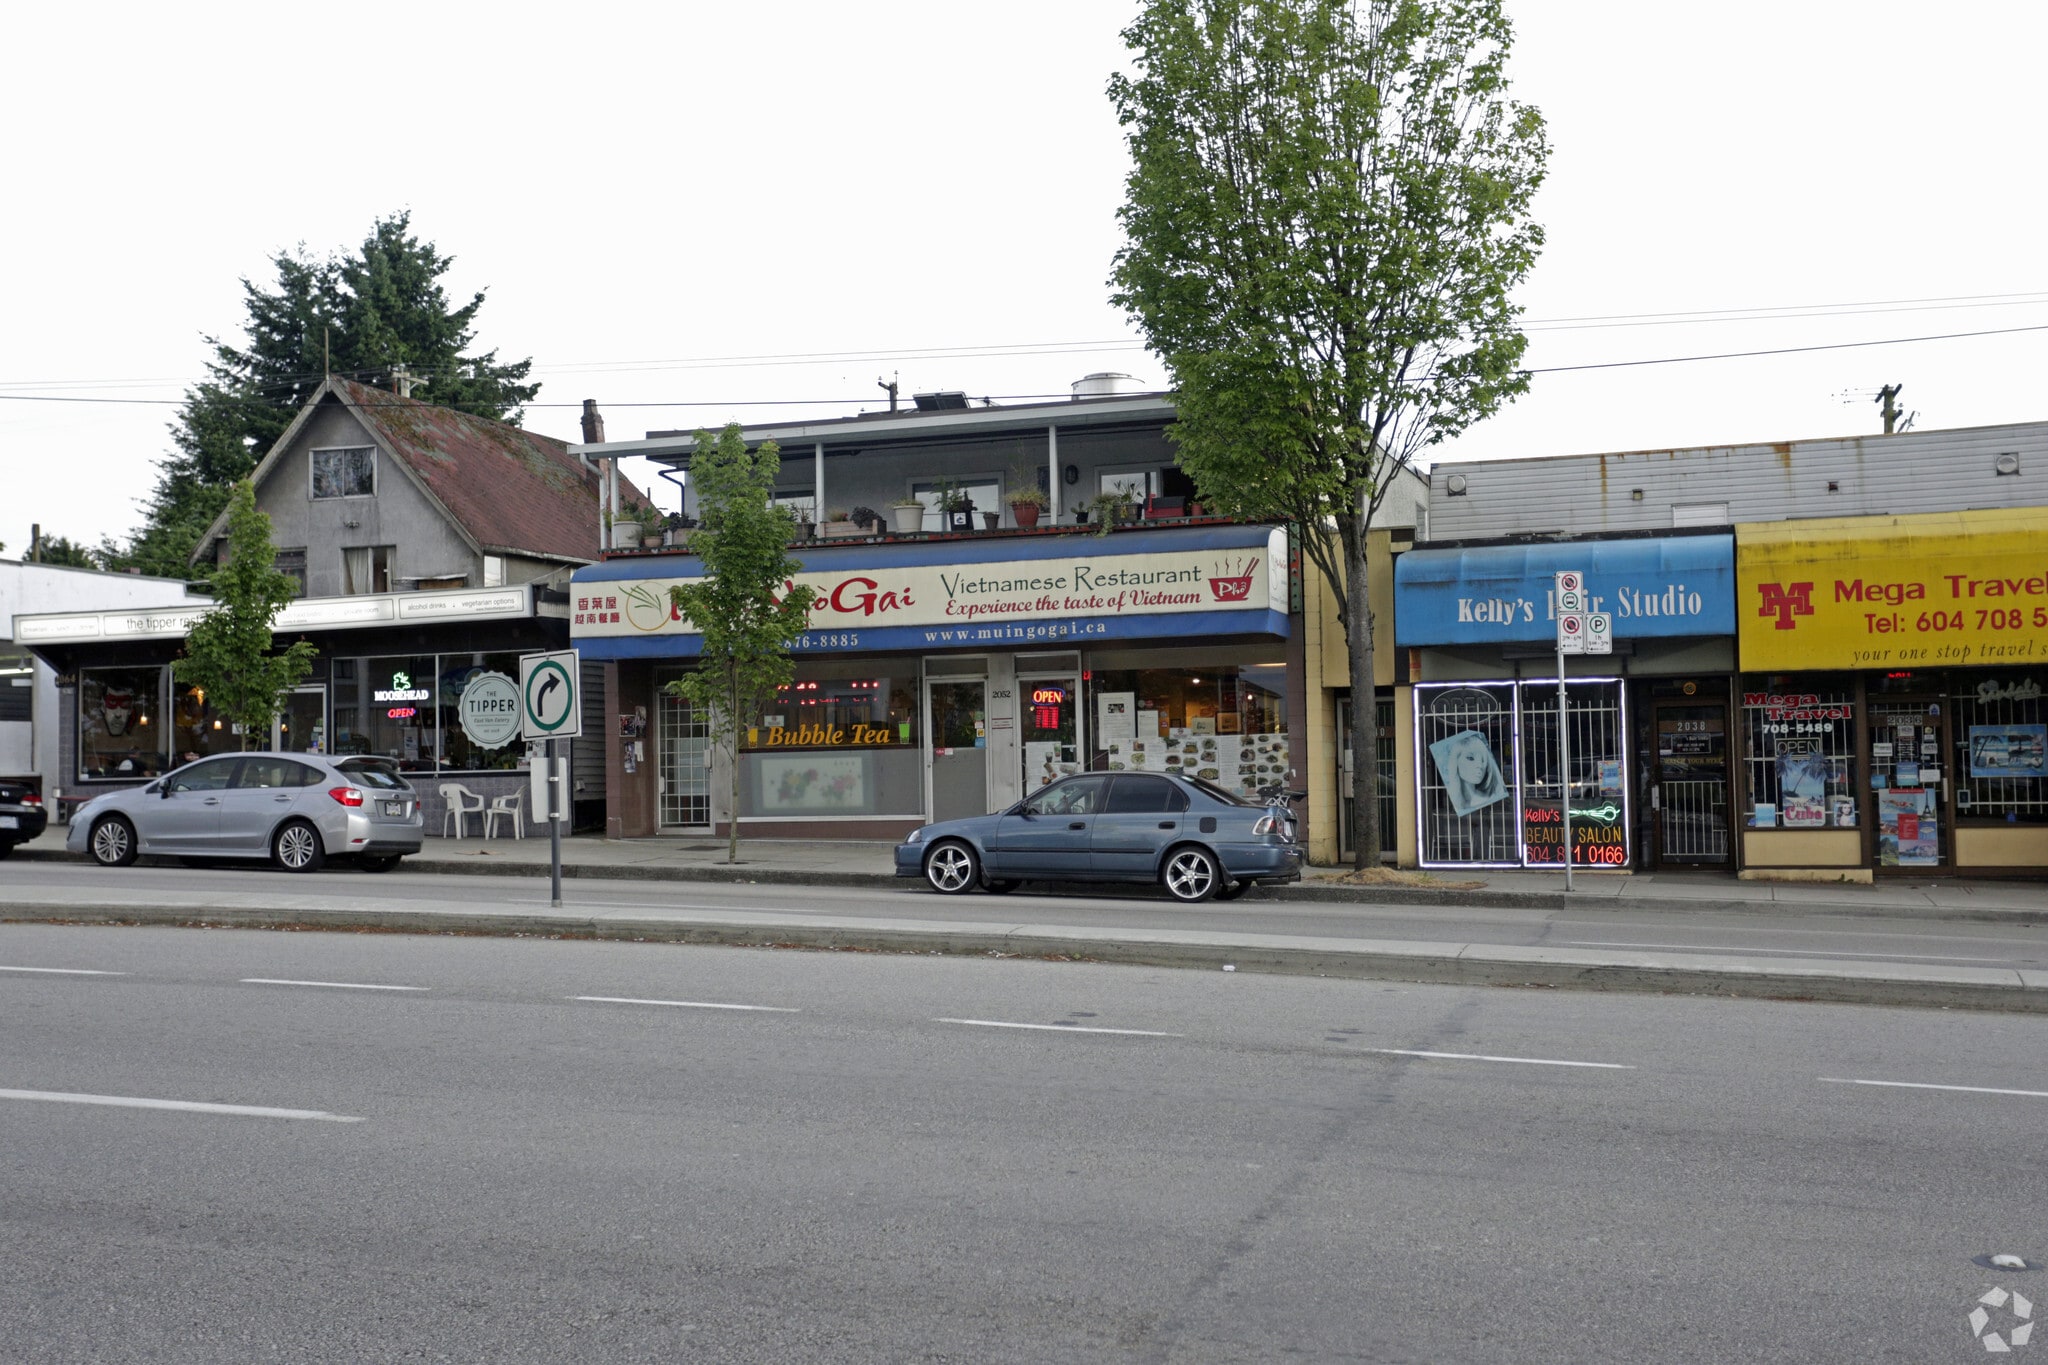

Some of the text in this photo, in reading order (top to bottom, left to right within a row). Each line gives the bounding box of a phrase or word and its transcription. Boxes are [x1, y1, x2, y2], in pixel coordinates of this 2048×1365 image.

[941, 564, 1202, 600] Vietnamese Restaurant
[1834, 578, 1926, 606] Mega
[945, 589, 1202, 620] Experience the taste of Vietnam
[1457, 597, 1534, 626] Kelly's
[1617, 583, 1702, 619] Studio
[126, 617, 144, 630] the
[146, 615, 176, 631] tipper
[1864, 612, 1906, 634] Tel:
[1915, 610, 1964, 633] 604
[1975, 608, 2023, 631] 708
[925, 620, 1107, 642] www.muingogai.ca
[1850, 646, 1891, 667] your
[1899, 645, 1928, 660] one
[1936, 642, 1971, 664] stop
[1980, 639, 2034, 658] travel
[374, 689, 429, 702] MOOSEHEAD
[992, 690, 1011, 699] 2052
[1033, 690, 1063, 704] OPEN
[1743, 692, 1819, 708] Mega
[387, 707, 415, 719] OPEN
[469, 699, 515, 713] TIPPER
[1765, 705, 1852, 721] Travel
[766, 722, 844, 747] Bubble
[850, 723, 891, 745] Tea
[1677, 721, 1706, 732] 2038
[1762, 722, 1833, 734] 708-5489
[1525, 808, 1561, 823] Kelly's
[1578, 826, 1622, 844] SALON
[1556, 845, 1582, 864] 81
[1588, 844, 1624, 864] 0166
